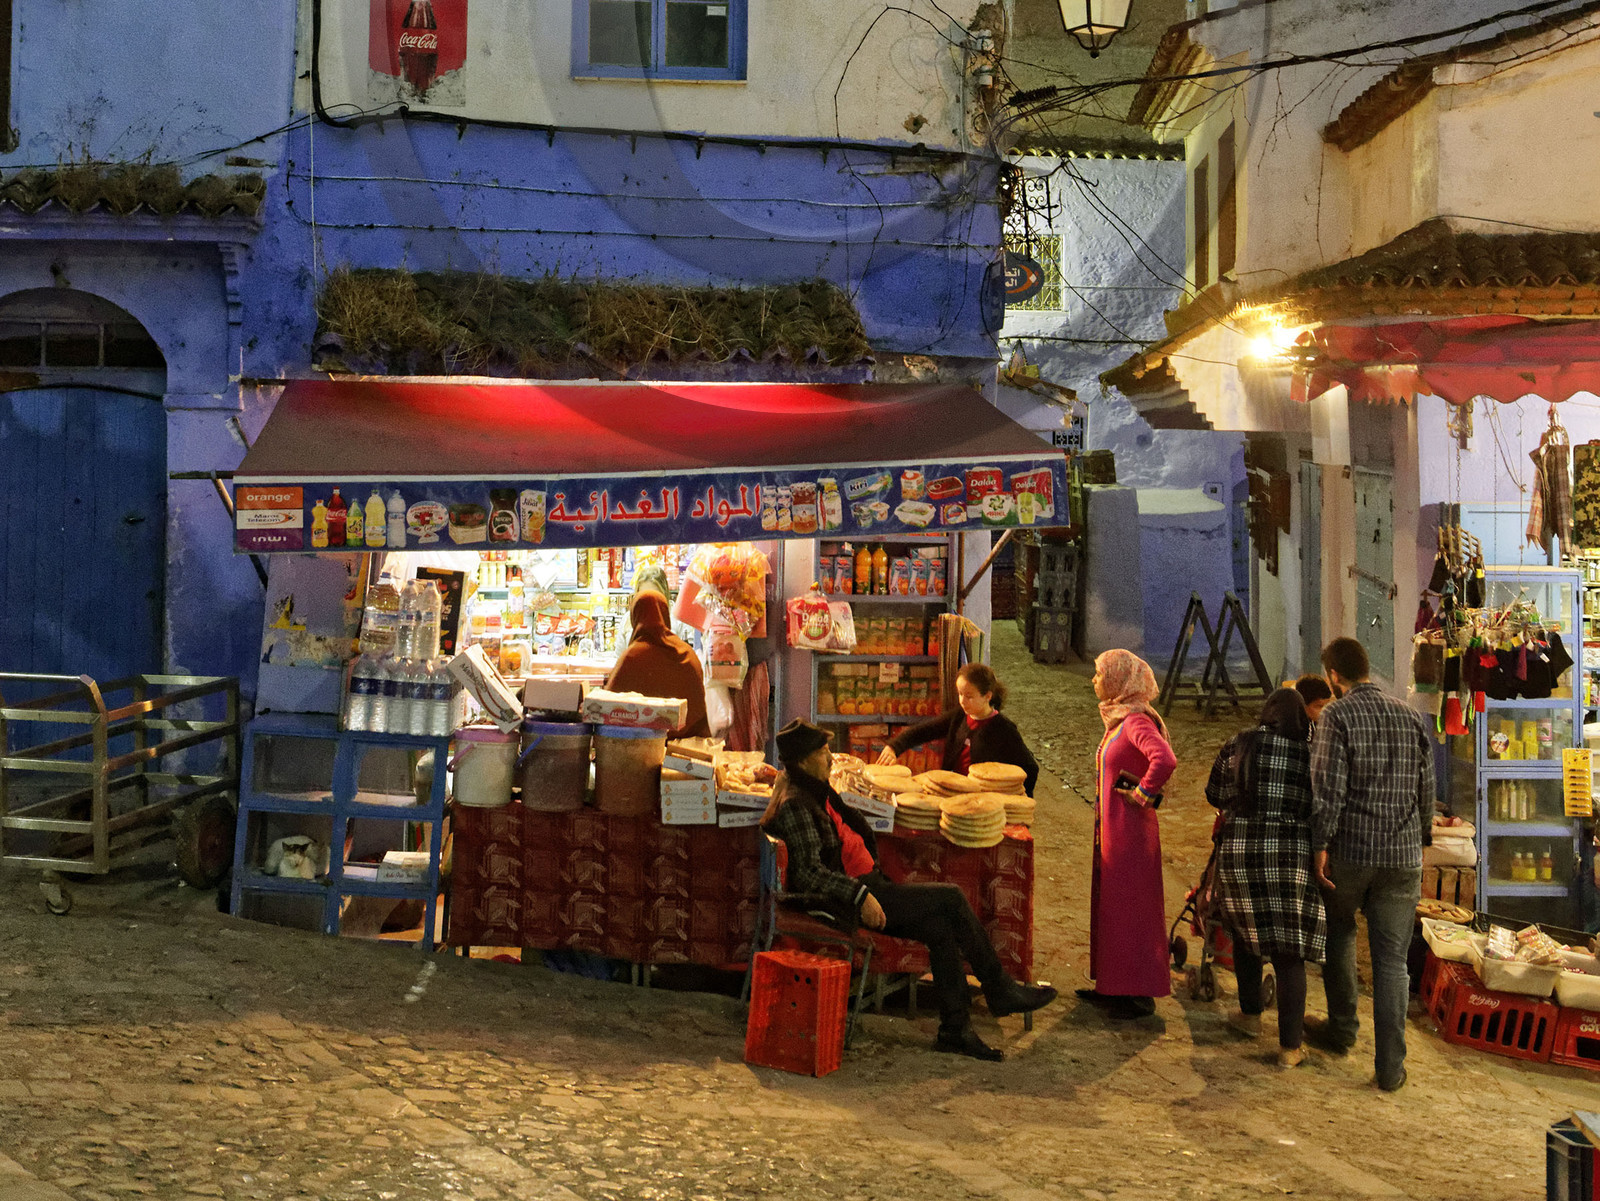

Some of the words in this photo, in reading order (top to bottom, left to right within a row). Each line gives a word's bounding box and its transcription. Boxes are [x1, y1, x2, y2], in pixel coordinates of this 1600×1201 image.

[400, 32, 438, 49] Coca-Cola
[849, 480, 868, 492] kiri
[691, 483, 761, 527] المواد
